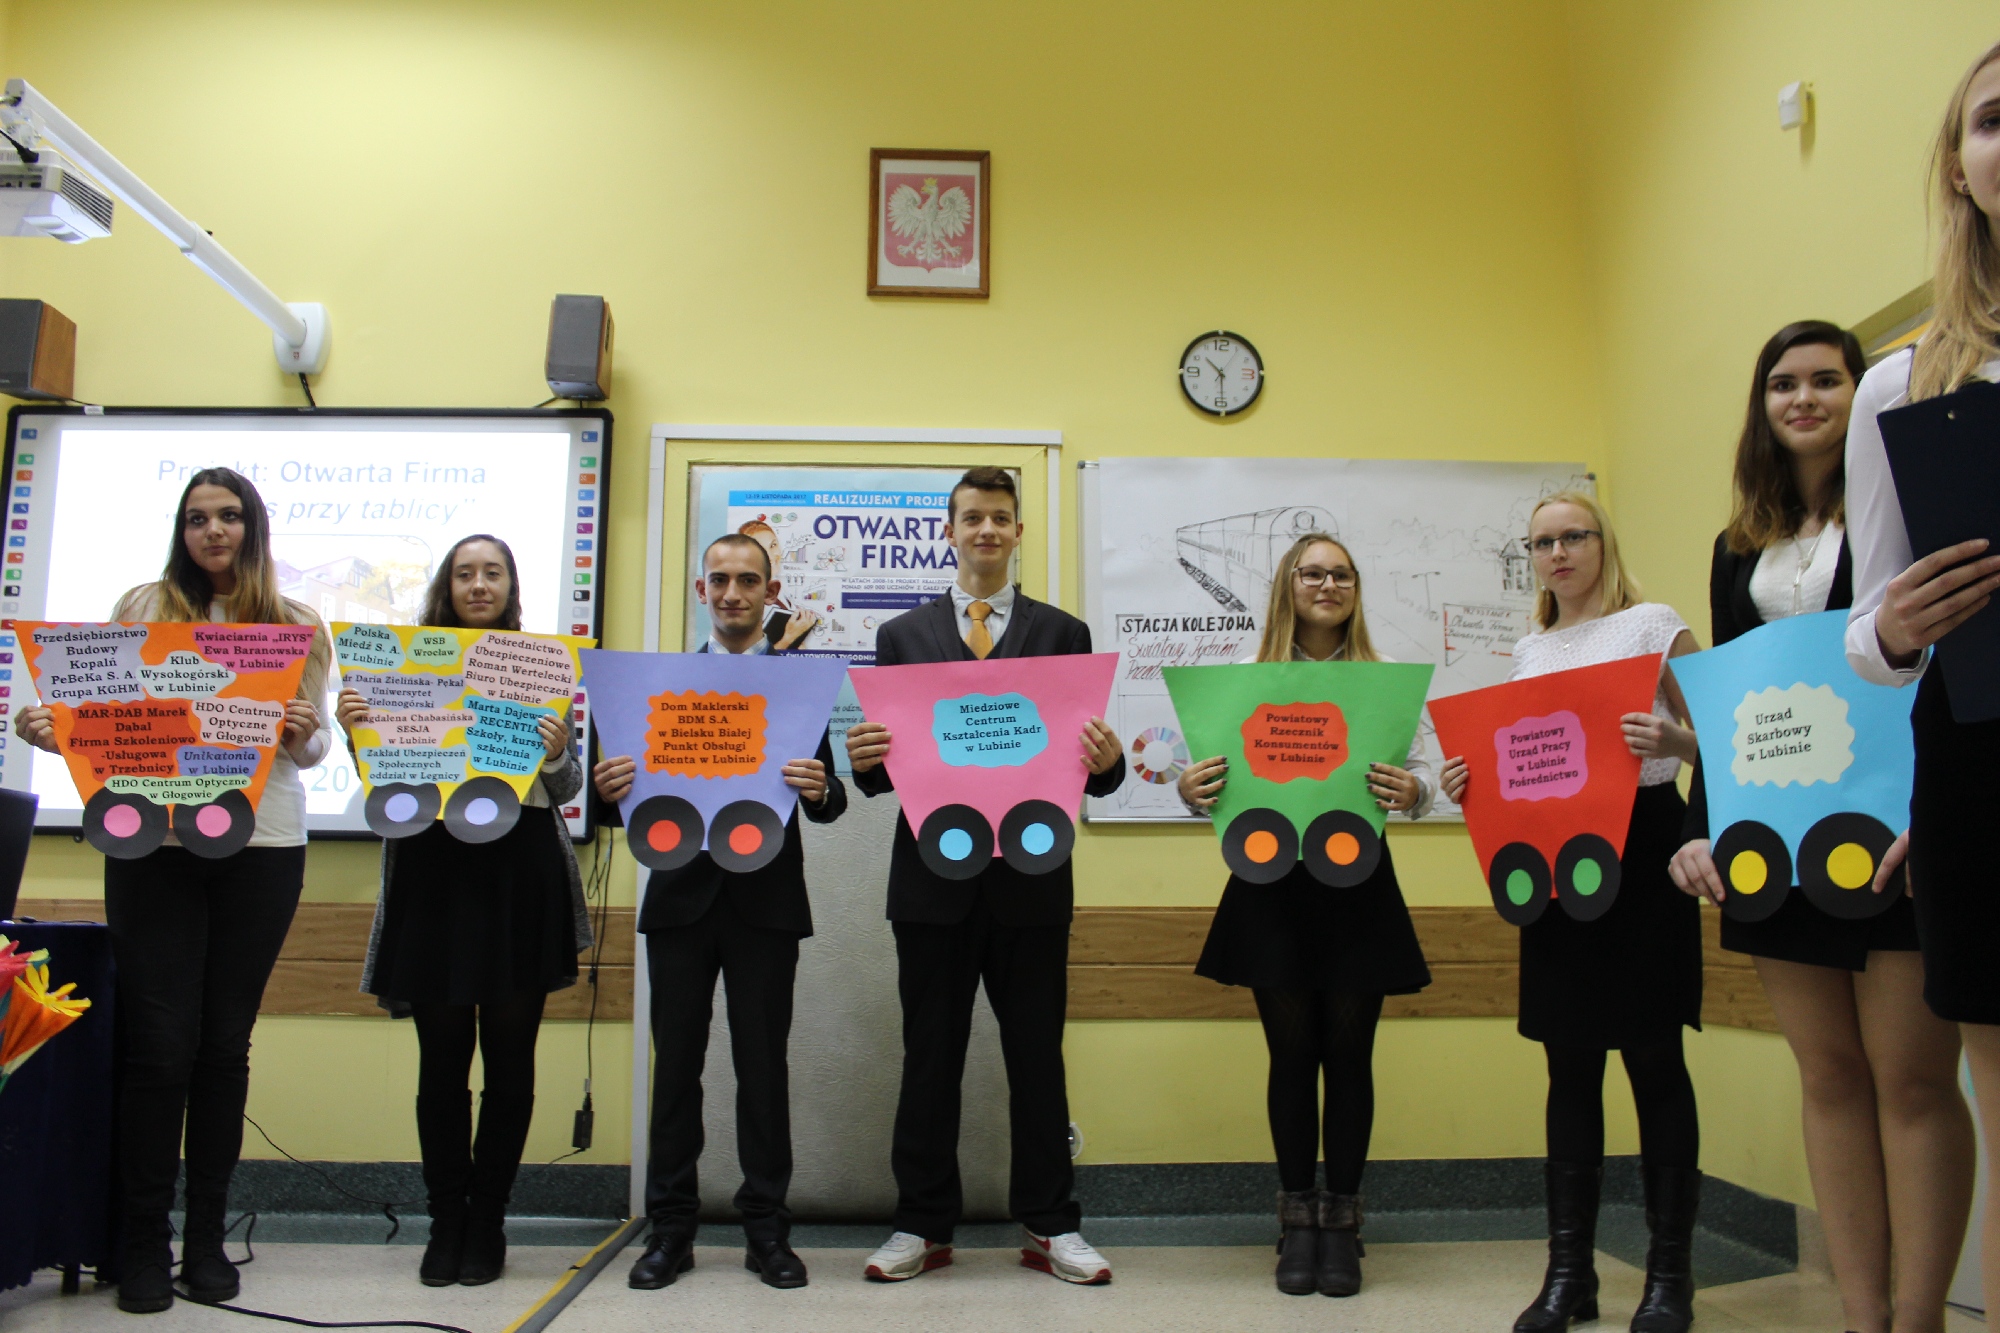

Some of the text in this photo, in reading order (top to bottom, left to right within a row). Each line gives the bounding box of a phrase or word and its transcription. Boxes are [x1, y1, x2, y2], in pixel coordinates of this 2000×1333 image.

[1213, 339, 1230, 351] 12
[1187, 366, 1199, 377] 9
[1241, 368, 1254, 380] 3
[1215, 397, 1227, 407] 6
[158, 460, 486, 484] Prokt: Otwarta Firma
[814, 494, 901, 506] REALIZUJEMY
[287, 501, 351, 525] przy
[861, 544, 958, 570] FIRMA
[1122, 618, 1178, 633] STACJA
[33, 629, 147, 644] Przedsiębiorstwo
[195, 632, 268, 641] Kwiaciarnia
[354, 626, 390, 640] Polska
[338, 637, 400, 655] Miedź S. A.
[423, 637, 446, 645] WSB
[487, 634, 563, 655] Pośrednictwo
[66, 645, 118, 656] Budowy
[204, 646, 304, 656] Ewa Baranowska
[413, 648, 455, 657] Wrocław
[70, 658, 117, 670] Kopalń
[170, 656, 199, 665] Klub
[240, 659, 285, 669] Lubinie
[352, 652, 394, 667] Lubinie
[475, 646, 570, 670] Ubezpieczeniowe
[141, 669, 229, 680] Wysokogórski
[468, 658, 572, 684] Roman Wertelecki
[51, 673, 102, 685] PeBeKa
[107, 671, 119, 680] S.
[343, 674, 353, 682] dr
[355, 674, 382, 684] Daria
[465, 671, 569, 697] Biuro Ubezpieczeń
[52, 684, 139, 699] Grupa KGHM
[154, 683, 216, 692] w Lubinie
[372, 686, 432, 698] Uniwersytet
[499, 689, 542, 704] Lubinie
[367, 697, 434, 709] Zielonogórski
[661, 702, 749, 711] Dom Maklerski
[960, 702, 1020, 714] Miedziowe
[78, 707, 187, 719] MAR-DAB Marek
[195, 702, 282, 718] HDO Centrum
[468, 700, 543, 720] Marta Dajews
[1755, 707, 1793, 725] Urząd
[209, 717, 267, 730] Optyczne
[410, 713, 473, 722] Chabasińska
[678, 715, 705, 724] BDM
[965, 715, 1016, 726] Centrum
[1266, 713, 1329, 726] Powiatowy
[397, 725, 430, 733] SESJA
[480, 716, 539, 734] RECENTIA
[466, 726, 507, 743] Szkoły,
[671, 728, 714, 738] Bielsku
[718, 728, 751, 739] Białej
[943, 725, 1041, 741] Kształcenia Kadr
[1270, 726, 1324, 737] Rzecznik
[1510, 727, 1565, 744] Powiatowy
[1747, 725, 1812, 745] Skarbowy
[69, 735, 196, 747] Firma Szkoleniowo
[216, 731, 271, 745] Głogowie
[399, 737, 437, 745] Lubinie
[663, 741, 746, 752] Punkt Obsługi
[978, 740, 1021, 751] Lubinie
[1254, 739, 1339, 750] Konsumentów
[1509, 740, 1571, 759] Urząd Pracy
[101, 750, 167, 763] -Usługowa
[184, 751, 256, 761] Unikatonia
[367, 749, 466, 759] Zakład Ubezpieczeń
[477, 743, 530, 759] szkolenia
[1746, 742, 1812, 762] w Lubinie
[485, 756, 528, 772] Lubinie
[652, 755, 695, 764] Klienta
[713, 754, 756, 764] Lubinie
[1280, 753, 1325, 763] Lubinie
[1516, 755, 1566, 772] w Lubinie
[109, 763, 174, 776] Trzebnicy
[203, 765, 250, 774] Lubinie
[378, 760, 441, 770] Społecznych
[369, 772, 406, 780] oddział
[421, 771, 460, 781] Legnicy
[1509, 769, 1578, 788] Pośrednictwo
[112, 777, 247, 788] HDO Centrum Optyczne
[150, 790, 212, 800] w Głogowie
